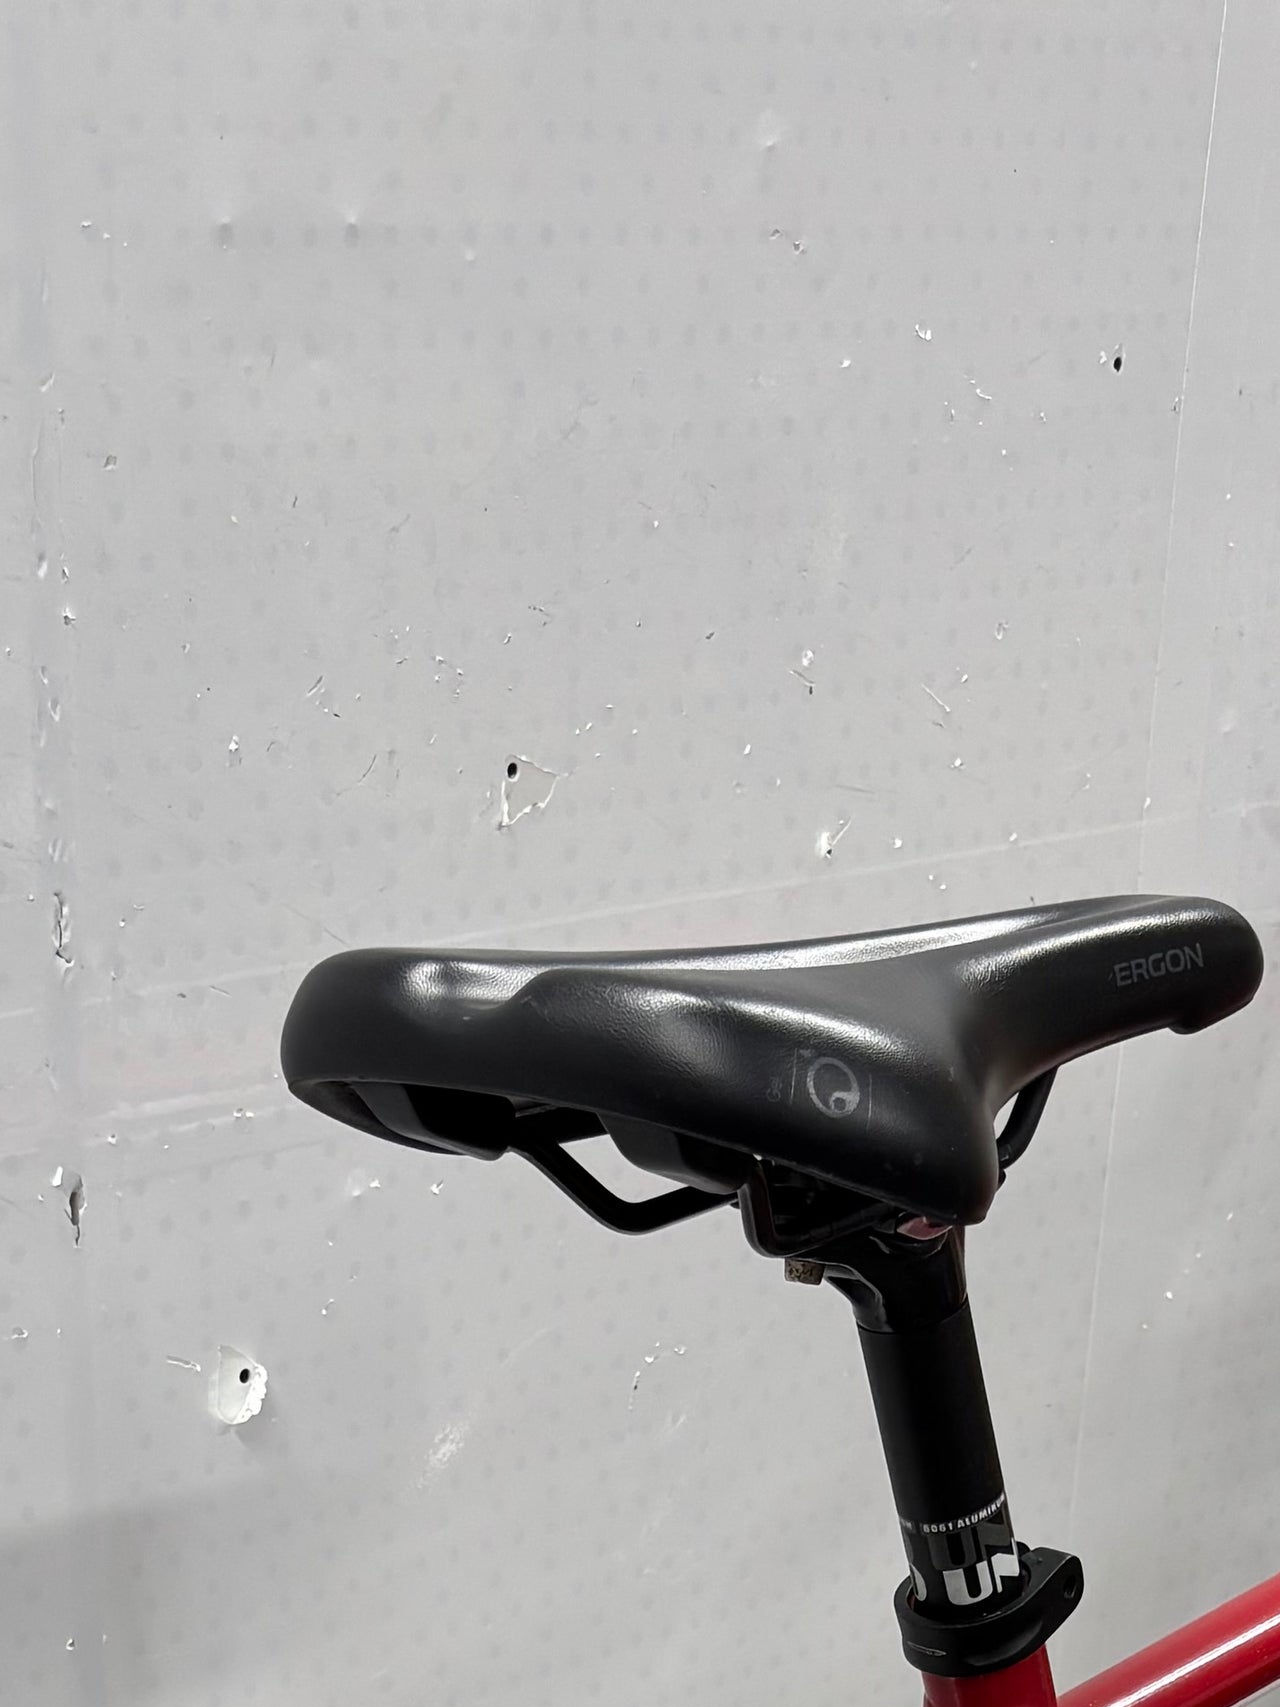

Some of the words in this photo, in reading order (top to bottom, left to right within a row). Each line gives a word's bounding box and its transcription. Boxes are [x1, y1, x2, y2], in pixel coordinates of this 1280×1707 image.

[1113, 942, 1204, 987] ERGON
[923, 1522, 954, 1534] 6061
[942, 1536, 1020, 1606] UN
